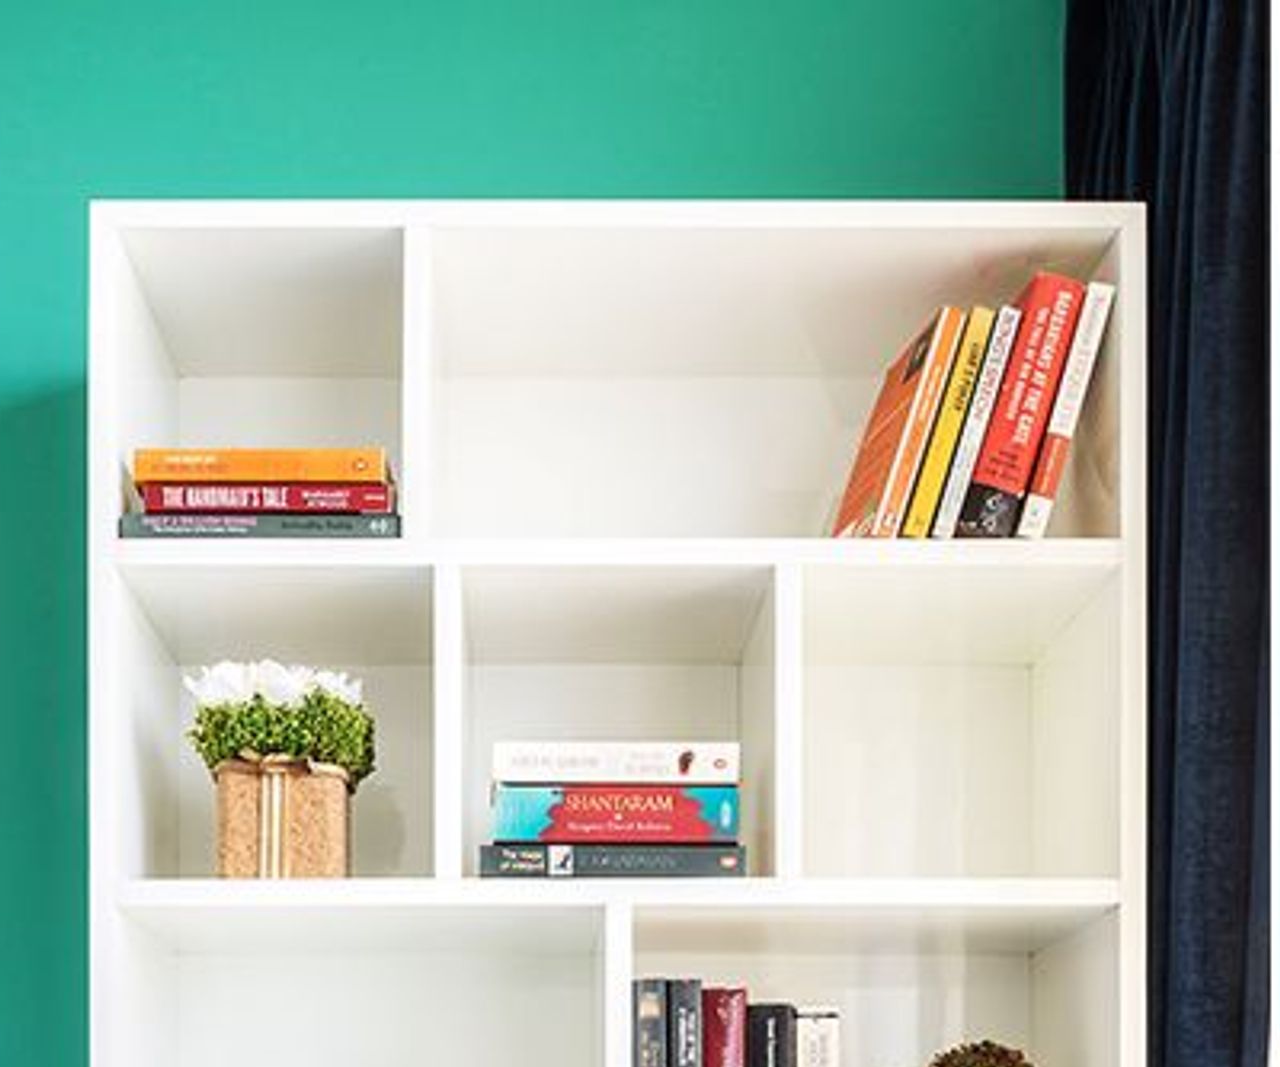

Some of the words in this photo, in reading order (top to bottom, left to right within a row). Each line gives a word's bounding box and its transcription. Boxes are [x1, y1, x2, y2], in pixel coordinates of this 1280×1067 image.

[162, 486, 183, 508] THE
[263, 486, 288, 508] TALE
[563, 795, 674, 812] SHANTARAM
